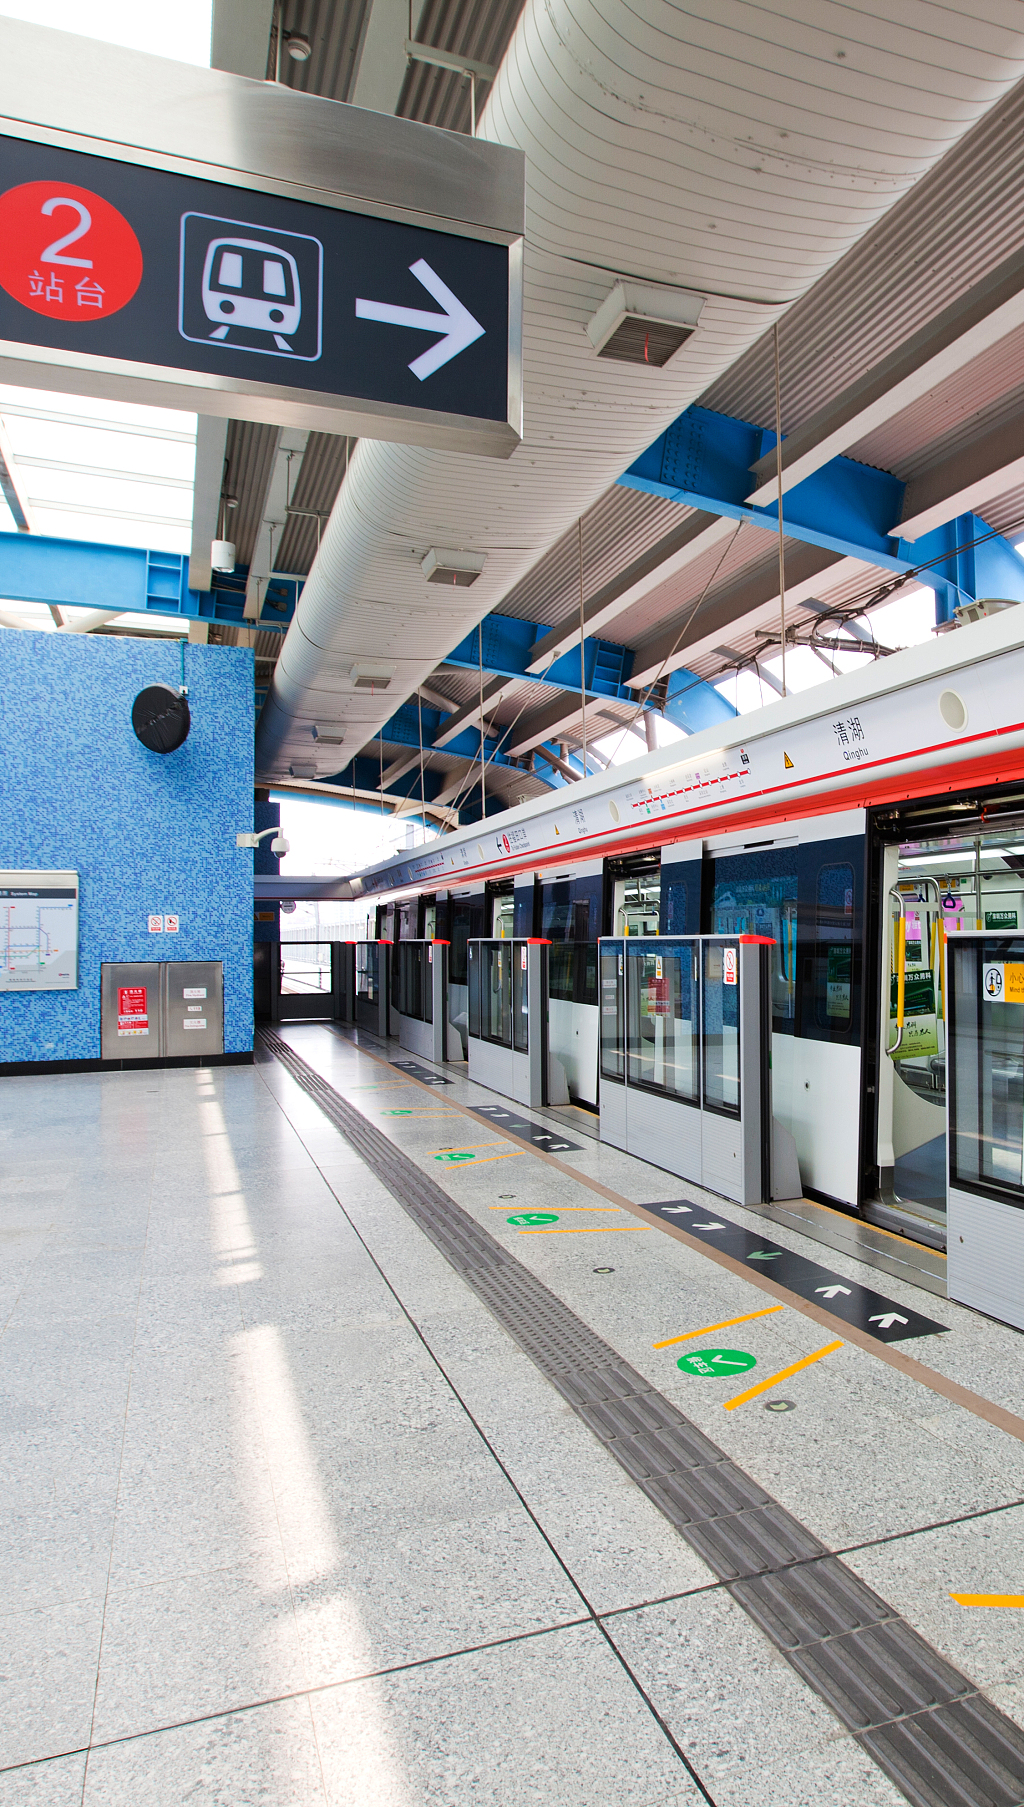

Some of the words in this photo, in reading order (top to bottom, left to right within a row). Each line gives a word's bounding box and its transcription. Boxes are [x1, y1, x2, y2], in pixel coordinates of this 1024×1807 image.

[40, 197, 93, 269] 2
[28, 269, 106, 309] 站台
[832, 717, 865, 746] 清湖
[843, 747, 869, 761] Qinghu
